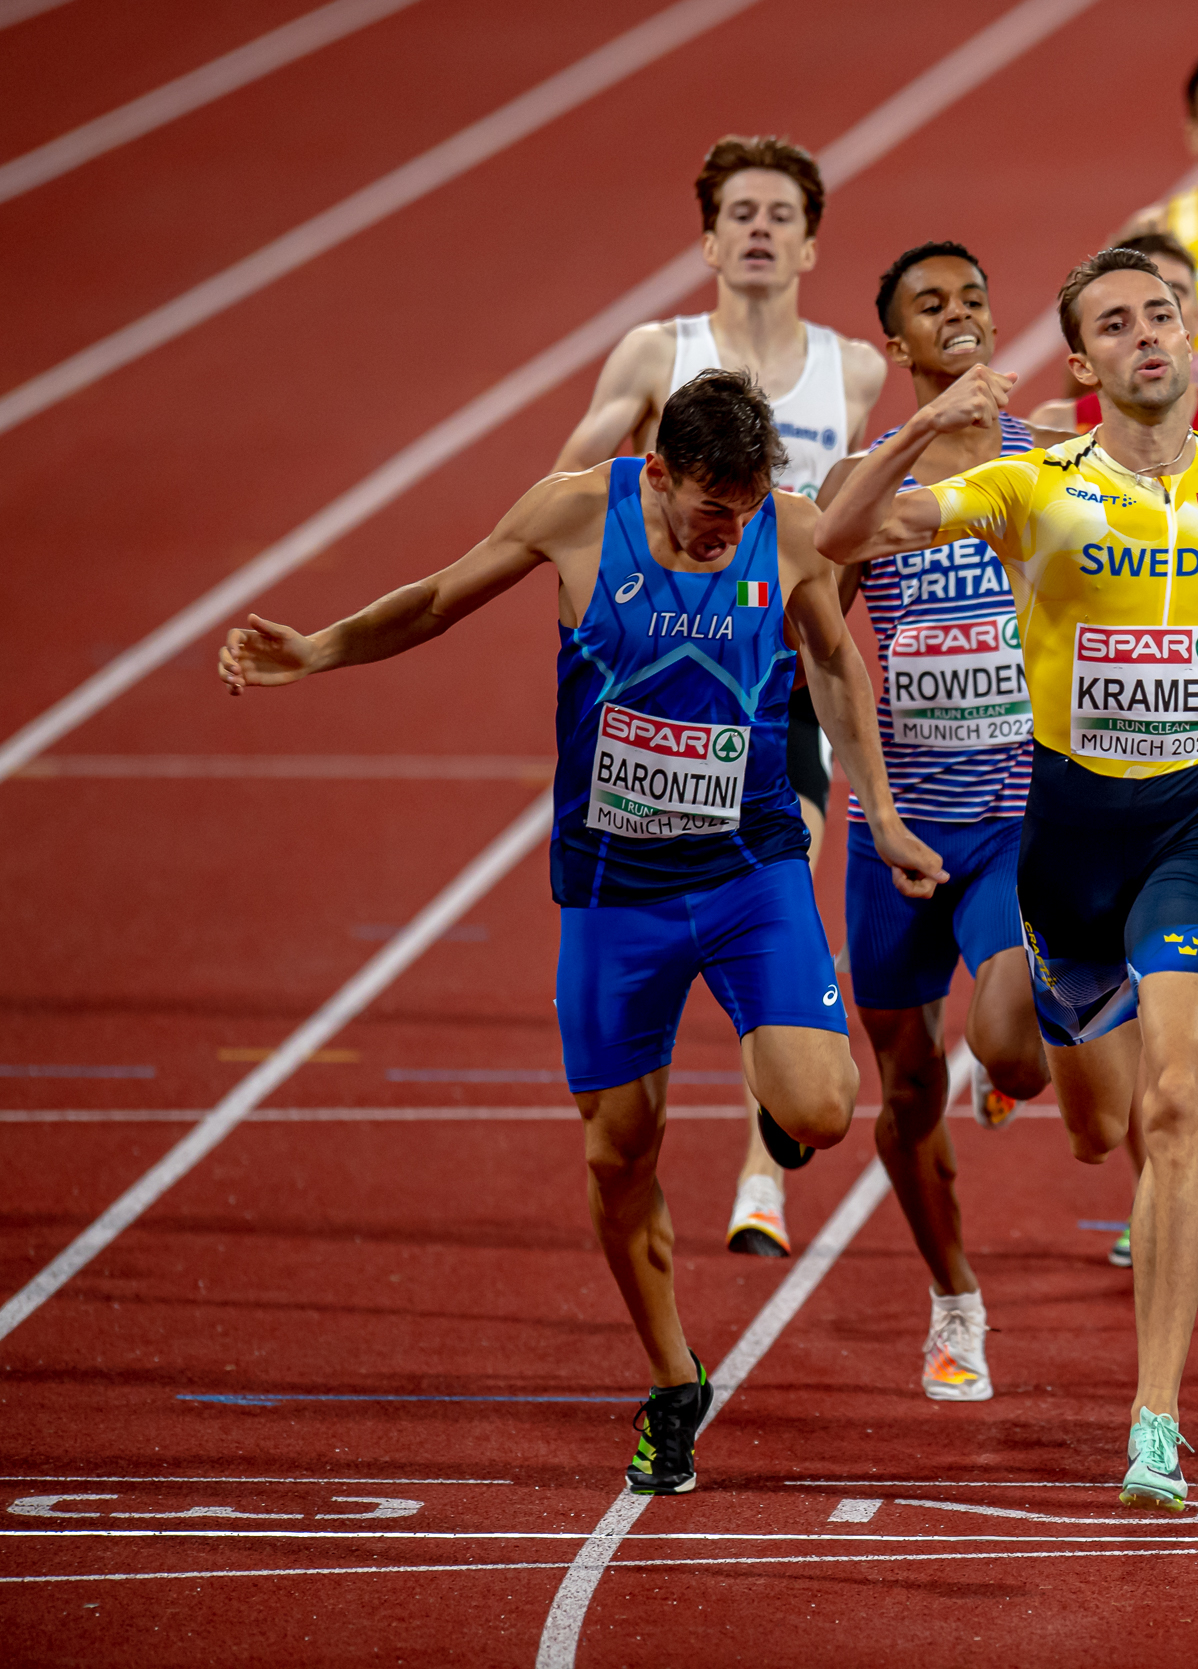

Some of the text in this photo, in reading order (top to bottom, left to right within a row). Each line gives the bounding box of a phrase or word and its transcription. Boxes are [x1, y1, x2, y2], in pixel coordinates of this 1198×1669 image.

[1066, 487, 1120, 505] CRAFT
[648, 612, 734, 640] ITALIA
[895, 625, 996, 654] SPAR
[1080, 633, 1190, 659] SPAR
[934, 707, 961, 720] RUN
[605, 711, 708, 755] SPAR
[903, 718, 1034, 741] MUNICH 2022
[1109, 720, 1190, 734] I RUN CLEAN
[1081, 733, 1164, 756] MUNICH
[597, 751, 738, 809] BARONTINI
[597, 806, 673, 835] MUNICH
[622, 799, 626, 809] I
[627, 801, 654, 816] RUN
[1025, 921, 1050, 976] CRAFT
